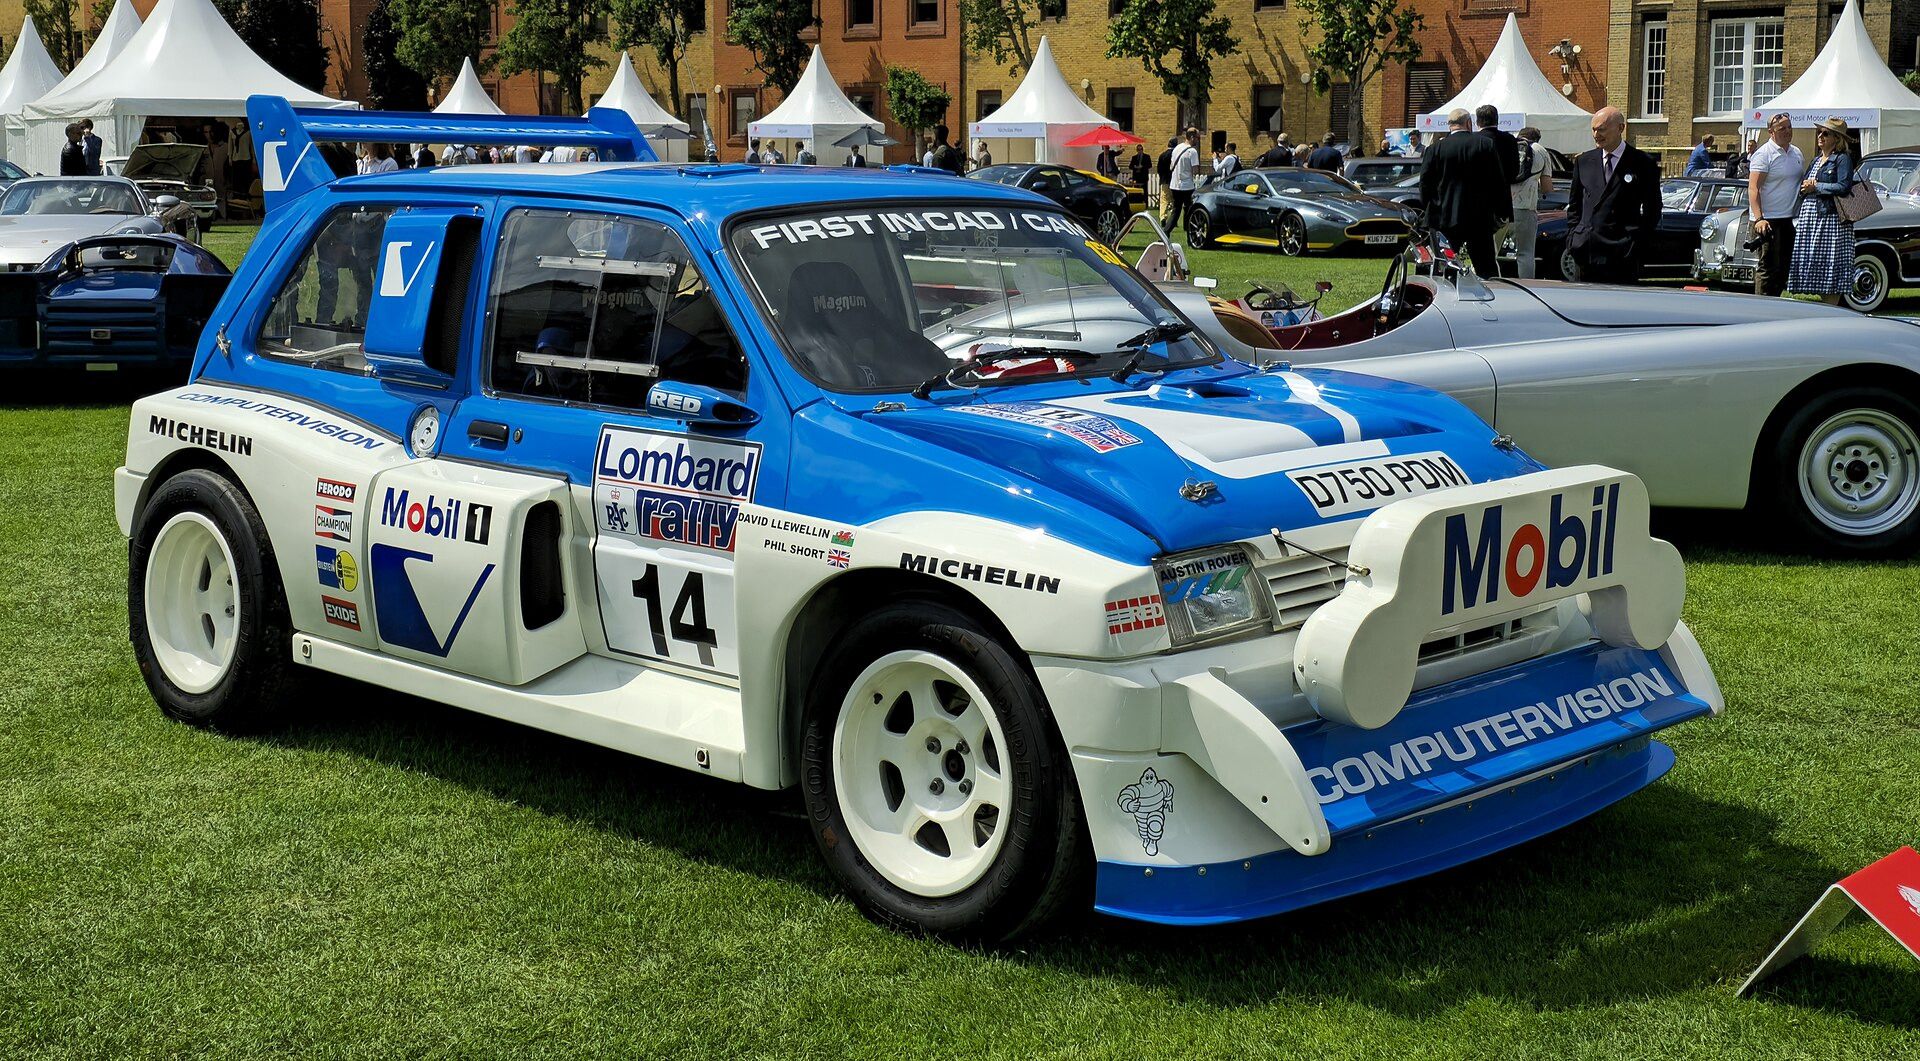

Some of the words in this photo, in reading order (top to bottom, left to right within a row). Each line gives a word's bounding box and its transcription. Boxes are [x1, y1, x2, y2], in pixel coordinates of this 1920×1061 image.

[1788, 114, 1805, 122] hesil
[1807, 114, 1826, 122] Motor
[751, 214, 875, 249] FIRST
[877, 213, 924, 233] IN
[920, 211, 1006, 231] CAD
[1021, 213, 1095, 241] CAM
[1740, 268, 1754, 279] 213
[582, 289, 645, 309] Magnum
[813, 295, 866, 312] Magnum
[651, 391, 702, 413] RED
[149, 415, 253, 456] MICHELIN
[176, 392, 384, 450] COMPUTERVISION
[599, 433, 755, 497] Lombard
[317, 482, 353, 499] FERODO
[1294, 466, 1396, 509] D750
[1383, 456, 1468, 493] PDM
[316, 515, 350, 533] CHAMPION
[381, 486, 462, 540] Mobil
[641, 497, 740, 550] rally
[738, 512, 768, 527] DAVID
[770, 519, 831, 539] LLEWELLIN
[764, 539, 787, 553] PHIL
[790, 544, 825, 560] SHORT
[1442, 482, 1621, 616] Mobil
[900, 552, 1061, 595] MICHELIN
[1160, 561, 1206, 582] AUSTIN
[1208, 552, 1249, 571] ROVER
[325, 603, 358, 624] EXIDE
[631, 563, 718, 667] 14
[1132, 602, 1164, 623] RED
[1305, 667, 1674, 804] COMPUTERVISION
